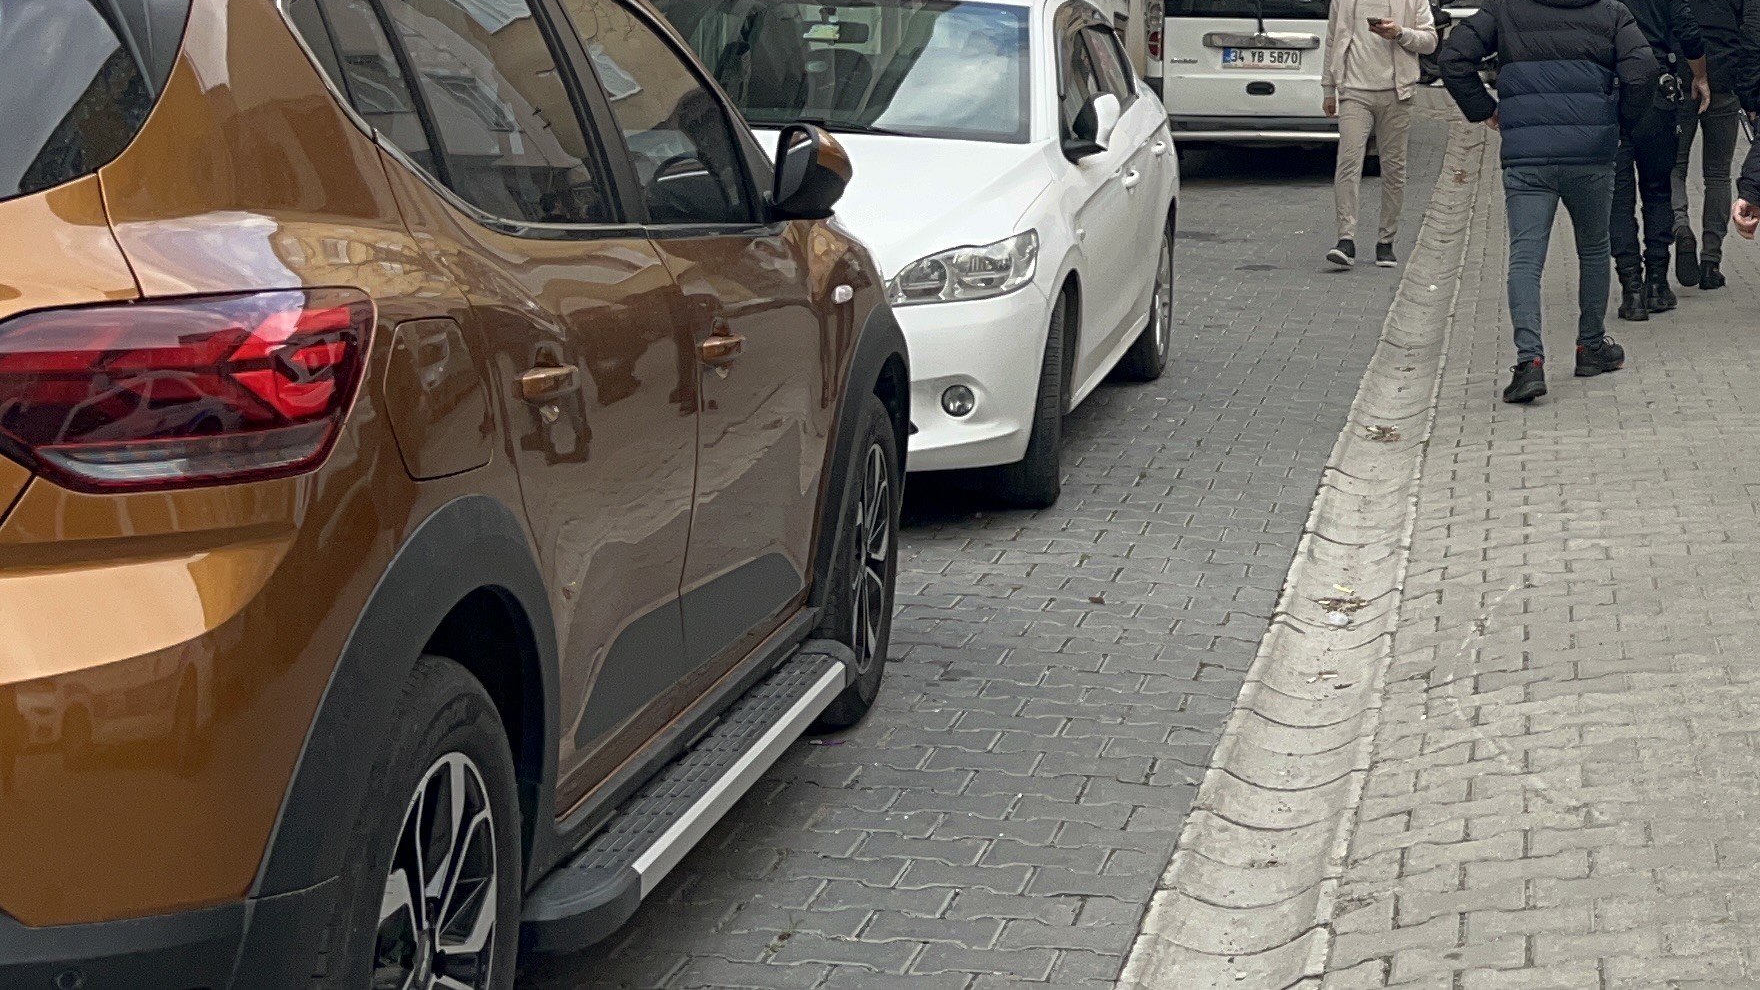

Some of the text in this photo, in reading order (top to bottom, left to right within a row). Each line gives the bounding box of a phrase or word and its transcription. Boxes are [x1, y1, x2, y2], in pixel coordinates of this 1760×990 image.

[1230, 51, 1298, 64] 34 YB 5870
